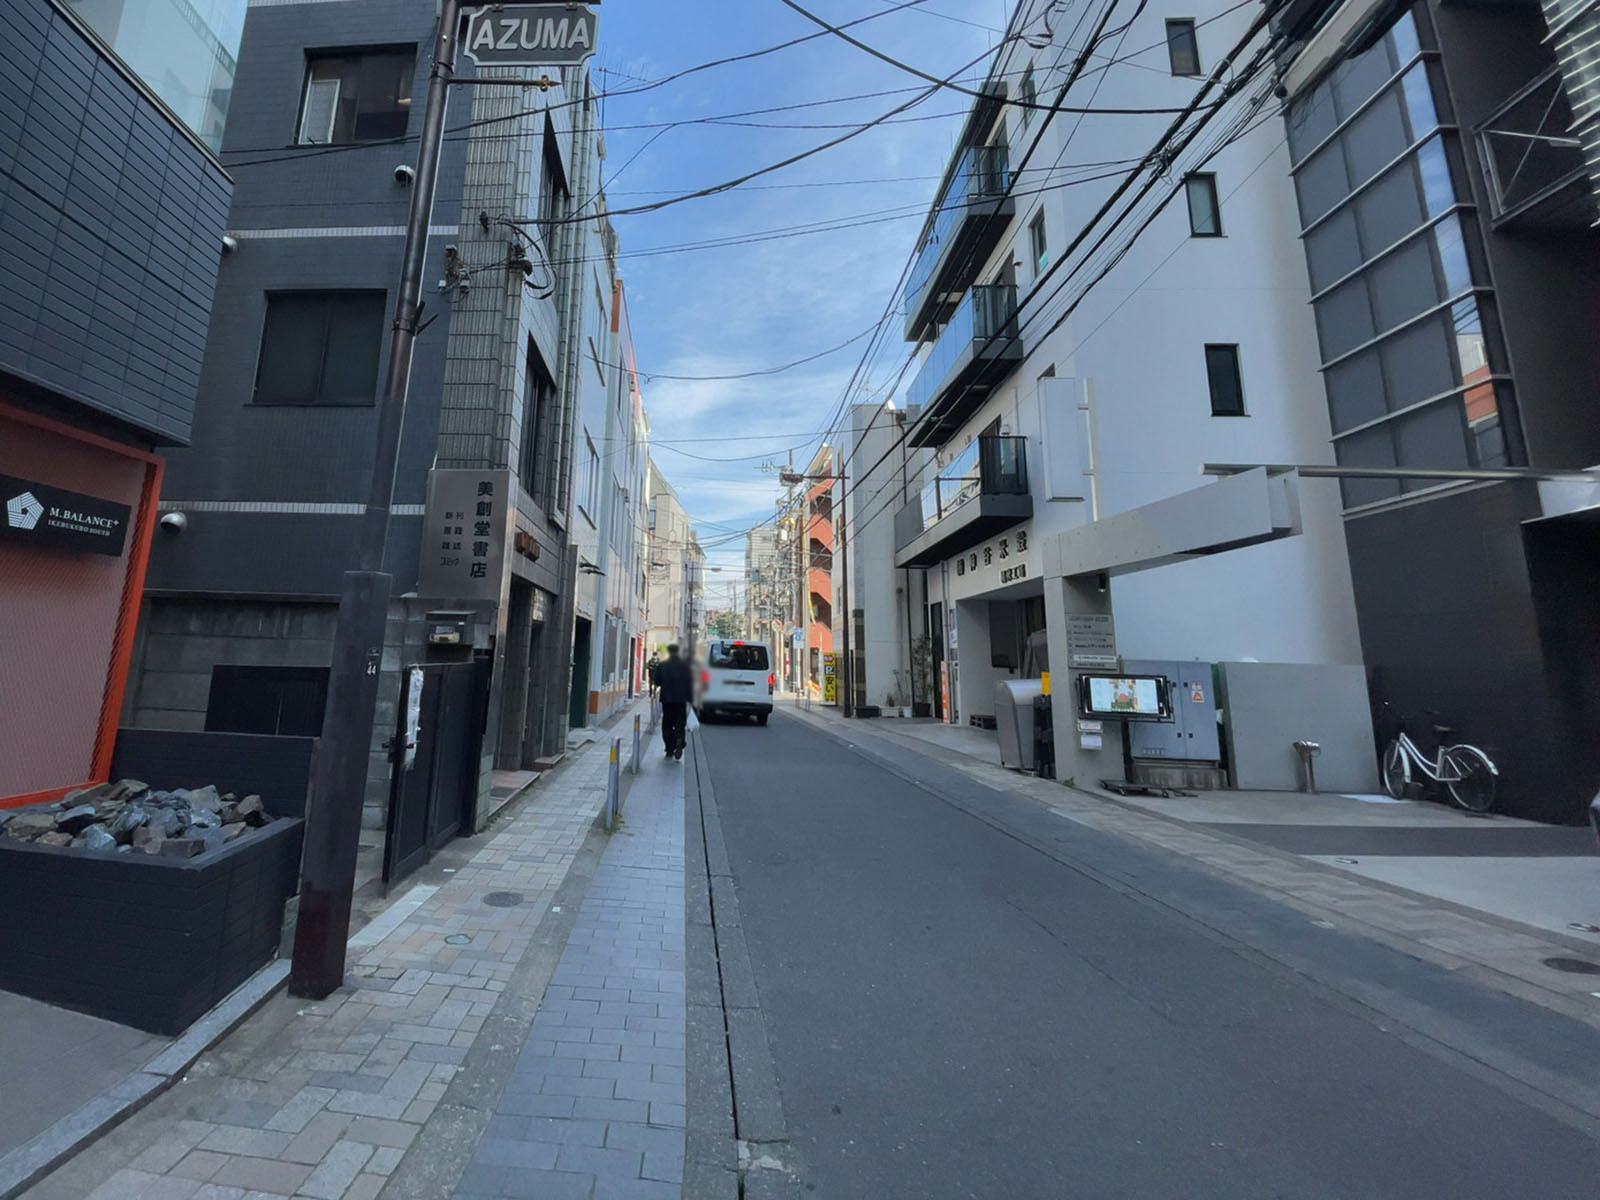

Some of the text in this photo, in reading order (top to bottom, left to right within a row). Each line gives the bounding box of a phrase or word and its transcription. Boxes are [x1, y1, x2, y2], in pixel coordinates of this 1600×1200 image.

[472, 18, 590, 50] AZUMA
[48, 520, 88, 533] IKEBUKURO
[470, 481, 494, 578] 美創堂書店
